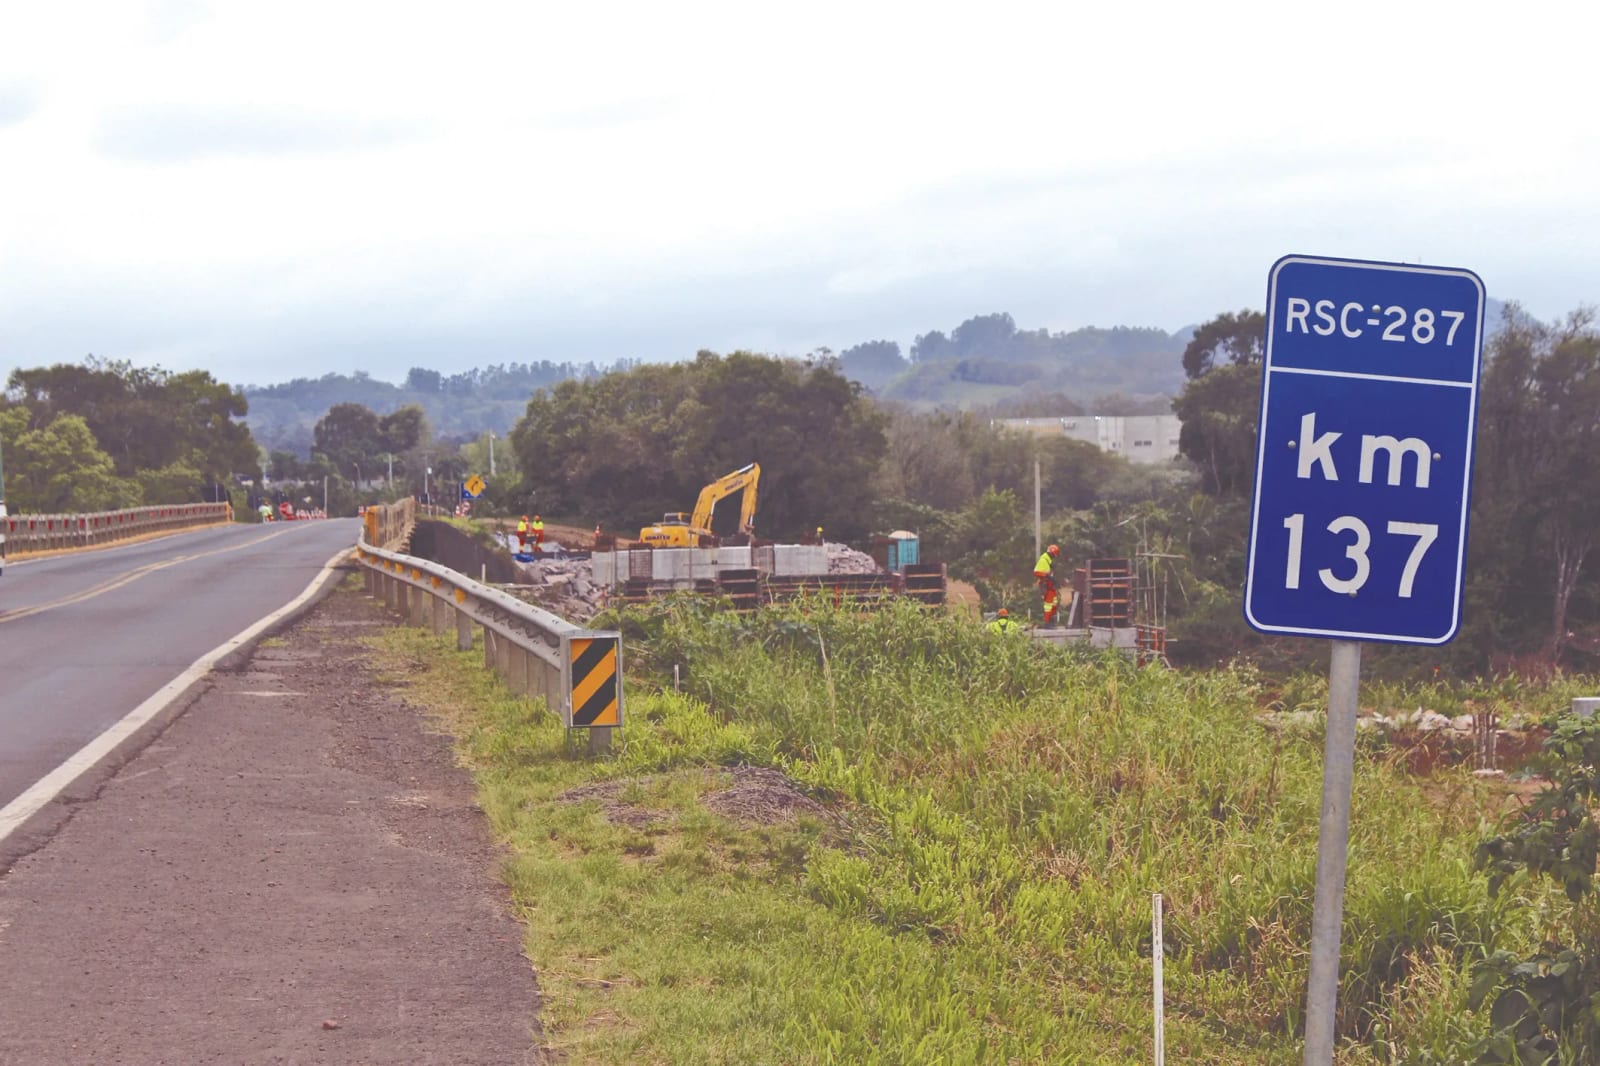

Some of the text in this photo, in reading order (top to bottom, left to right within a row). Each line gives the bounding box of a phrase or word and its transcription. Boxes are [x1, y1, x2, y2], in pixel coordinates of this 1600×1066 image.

[1286, 298, 1465, 346] RSC-287
[1297, 412, 1432, 488] km
[1283, 513, 1439, 597] 137
